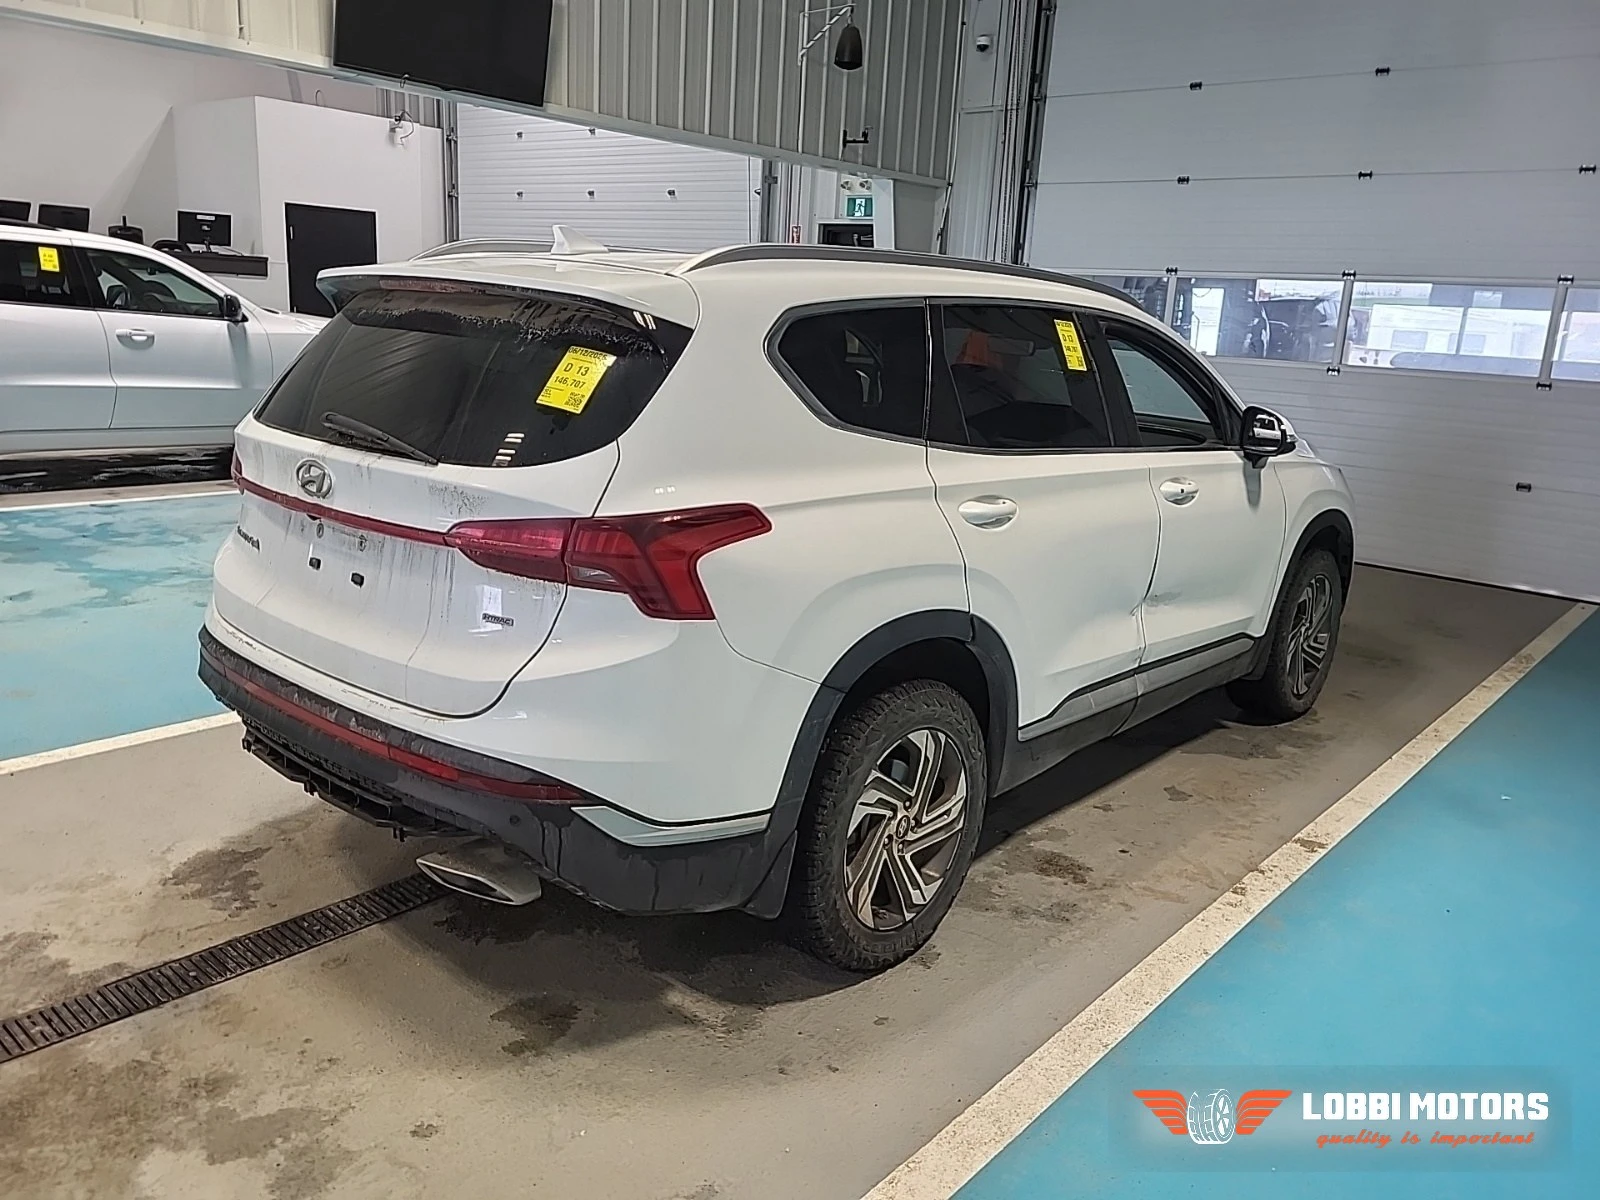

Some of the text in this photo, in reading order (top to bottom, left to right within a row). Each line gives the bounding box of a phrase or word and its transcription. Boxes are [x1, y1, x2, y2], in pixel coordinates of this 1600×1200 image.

[563, 362, 590, 377] D 13
[554, 375, 586, 389] 146,707
